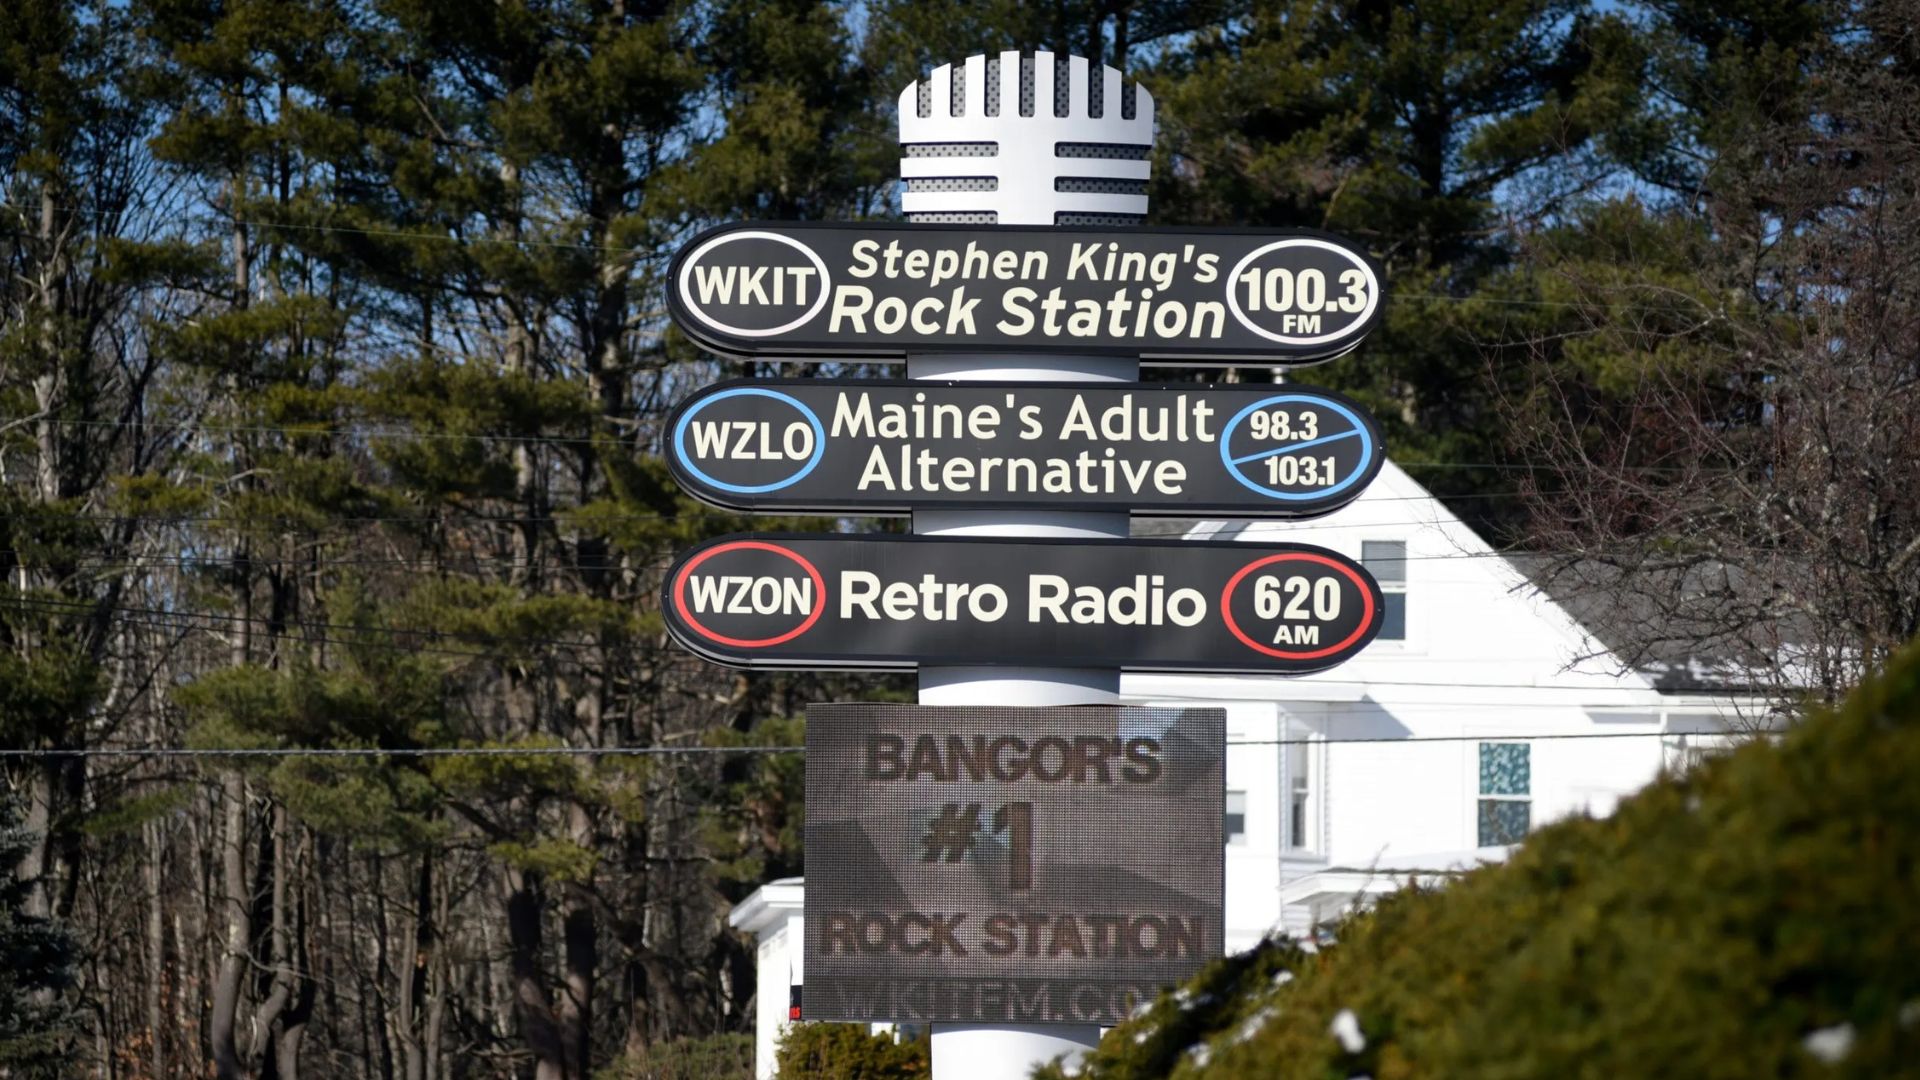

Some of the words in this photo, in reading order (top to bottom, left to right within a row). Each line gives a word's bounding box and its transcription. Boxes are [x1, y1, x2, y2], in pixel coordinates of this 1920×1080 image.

[694, 265, 817, 306] WKIT
[847, 240, 1049, 288] Stephen
[1066, 242, 1220, 291] King's
[828, 284, 983, 335] Rock
[995, 286, 1226, 339] Station
[1239, 267, 1368, 314] 100.3
[1282, 314, 1322, 335] FM
[691, 420, 814, 461] WZLO
[830, 391, 1043, 442] Maine's
[1058, 393, 1216, 443] Adult
[1250, 410, 1319, 441] 98.3
[856, 443, 1187, 495] Alternative
[1264, 455, 1336, 486] 103.1
[689, 574, 812, 616] WZON
[840, 570, 1009, 623] Retro
[1028, 574, 1208, 628] Radio
[1253, 574, 1341, 622] 620
[1272, 624, 1320, 646] AM
[865, 733, 1163, 784] BANGOR'S
[920, 801, 1034, 891] #1
[819, 911, 968, 957] ROCK
[982, 913, 1205, 960] STATION
